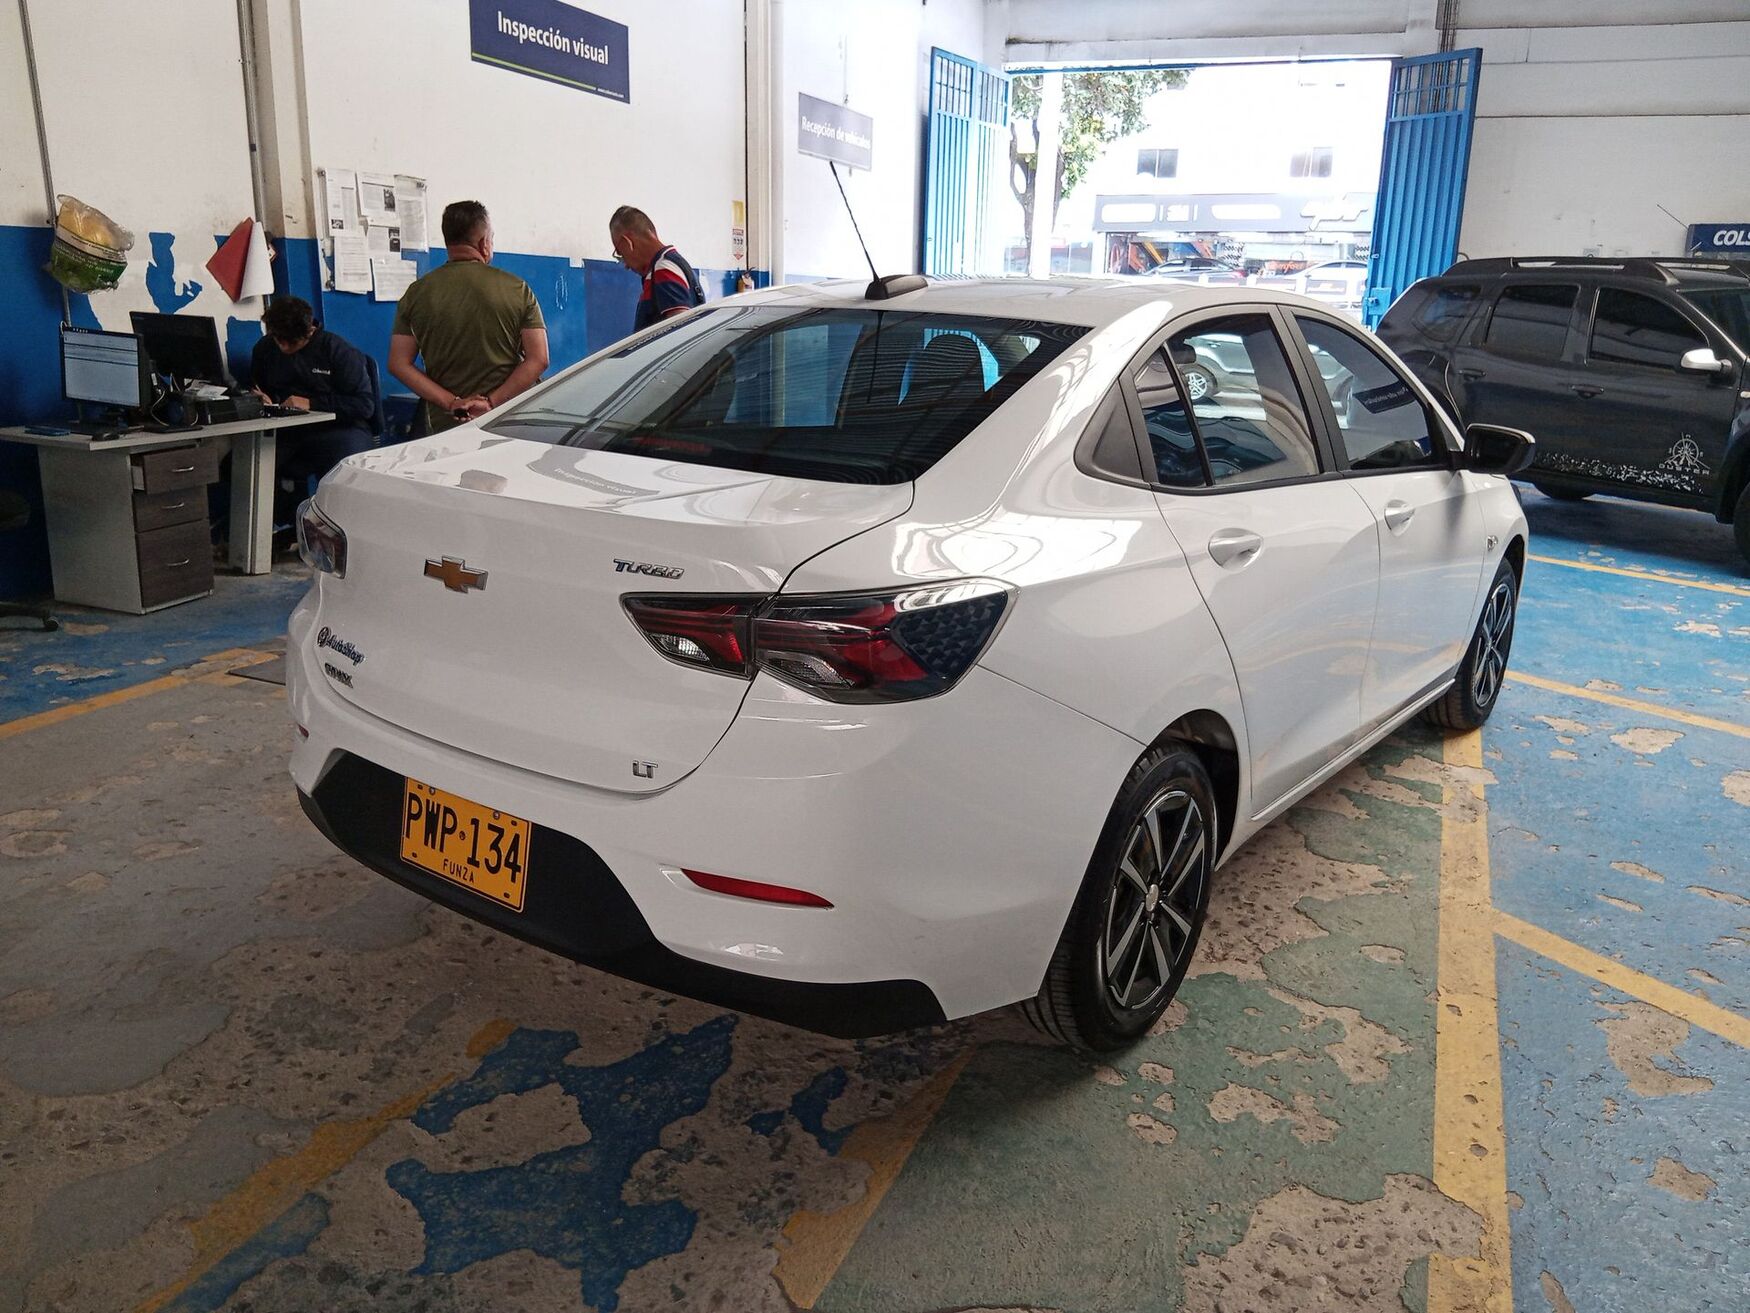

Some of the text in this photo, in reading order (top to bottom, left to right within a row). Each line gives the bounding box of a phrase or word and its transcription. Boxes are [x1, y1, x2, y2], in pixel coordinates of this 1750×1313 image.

[497, 11, 609, 65] Inspección visual
[801, 115, 836, 138] Recepción
[836, 127, 845, 141] de
[1658, 463, 1710, 475] DUSTER
[613, 558, 685, 580] TURBO
[632, 760, 659, 779] LT
[442, 858, 475, 884] FUNZA
